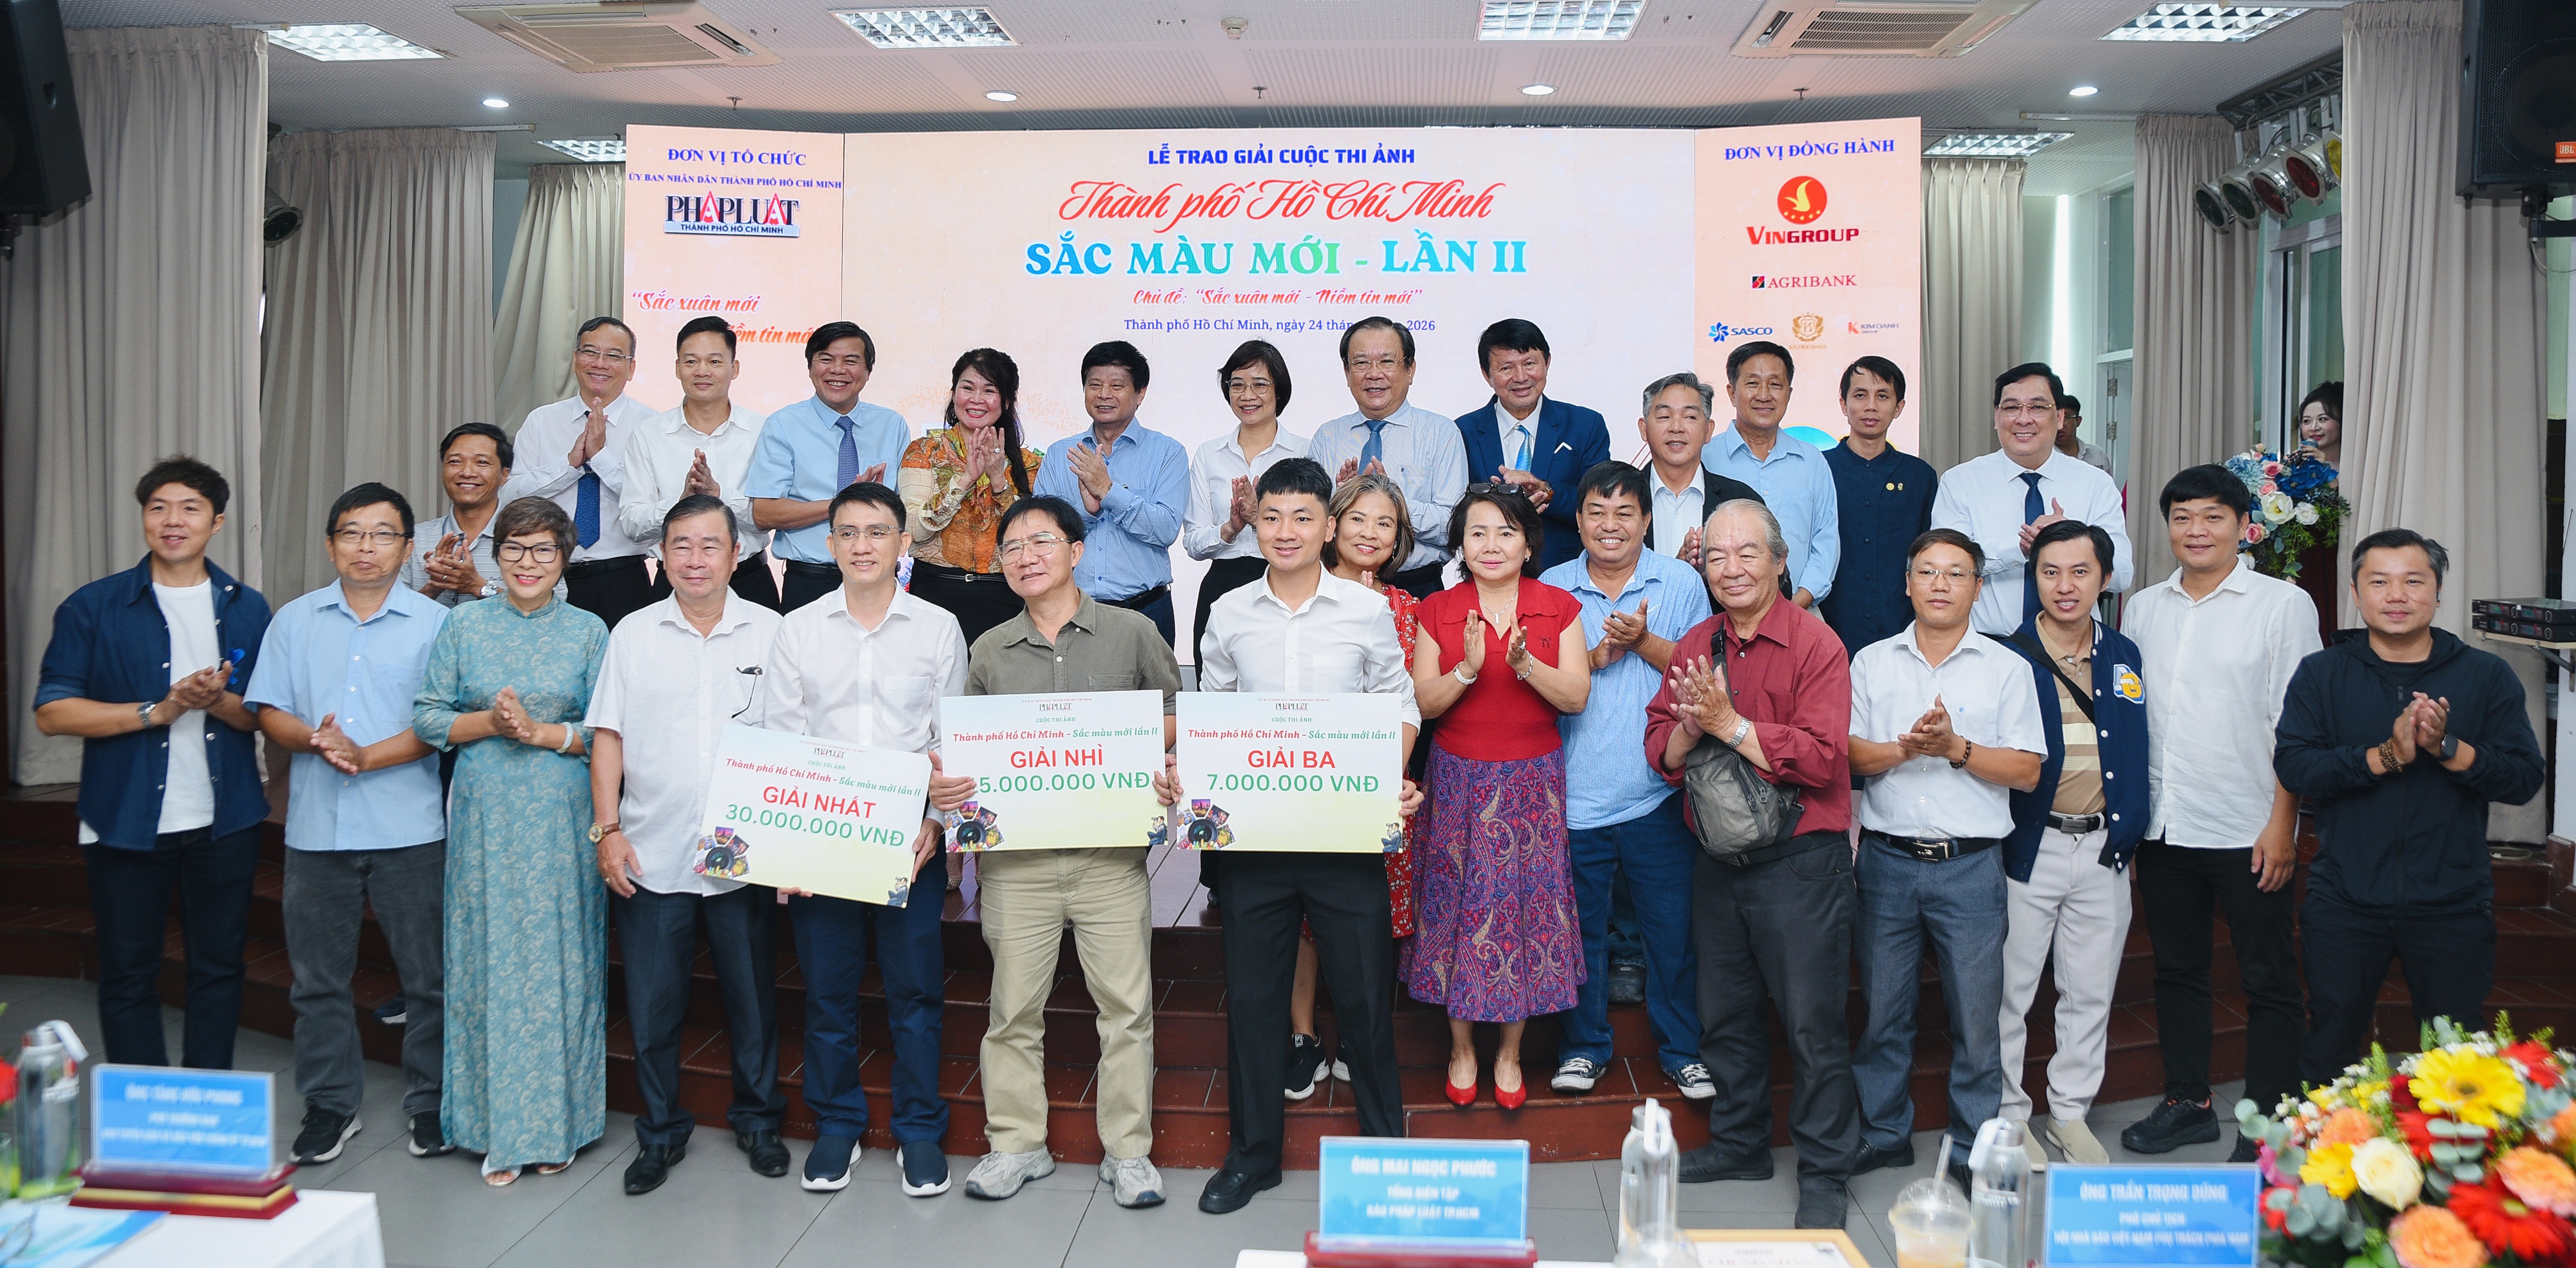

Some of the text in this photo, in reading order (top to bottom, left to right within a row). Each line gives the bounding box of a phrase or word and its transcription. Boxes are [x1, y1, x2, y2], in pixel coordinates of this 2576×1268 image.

[668, 148, 806, 166] ĐƠN VỊ TỔ CHỨC
[1149, 143, 1414, 167] LỄ TRAO GIẢI CUỘC THI ẢNH
[1725, 146, 1761, 160] ĐƠN
[1766, 146, 1784, 160] VỊ
[1844, 138, 1895, 154] HÀNH
[2560, 145, 2574, 154] JBL
[667, 174, 694, 183] NHÂN
[697, 175, 718, 184] DÂN
[720, 176, 754, 185] THÀNH
[796, 178, 813, 187] CHÍ
[816, 180, 842, 188] MINH
[1059, 179, 1506, 233] Thành phố Hồ Chí Minh
[1747, 226, 1859, 245] VINGROUP
[1026, 231, 1111, 274] SẮC
[1126, 236, 1233, 274] MÀU
[1249, 235, 1340, 274] MỚI
[1382, 229, 1477, 273] LẦN
[1492, 241, 1526, 272] II
[1768, 275, 1857, 288] AGRIBANK
[678, 295, 721, 311] xuân
[725, 295, 760, 312] mới
[1133, 289, 1160, 304] Chủ
[1163, 288, 1187, 304] đề:
[1233, 290, 1268, 304] xuân
[1270, 289, 1301, 304] mới
[1315, 288, 1357, 304] Niềm
[1360, 289, 1381, 304] tin
[727, 323, 818, 344] ềm tin mớ
[1125, 319, 1435, 332] Thành phố Hồ Chí Minh, ngày 24 thán 2026
[1731, 327, 1773, 335] SASCO
[954, 732, 983, 742] Thành
[986, 731, 1004, 743] phố
[1006, 730, 1018, 740] Hồ
[1021, 730, 1036, 739] Chí
[1039, 730, 1064, 739] Minh
[1073, 727, 1089, 738] Sắc
[1092, 728, 1112, 737] màu
[1114, 727, 1132, 736] mới
[1134, 726, 1149, 735] lần
[1188, 729, 1218, 739] Thành
[1221, 728, 1239, 740] phố
[1241, 728, 1253, 738] Hồ
[1255, 730, 1271, 738] Chí
[1309, 730, 1325, 739] Sắc
[1327, 731, 1348, 739] màu
[1351, 731, 1369, 739] mới
[1371, 729, 1387, 739] lần
[1010, 744, 1103, 768] GIẢI NHÌ
[1248, 746, 1336, 768] GIẢI BA
[726, 758, 755, 770] Thành
[756, 764, 776, 774] phố
[776, 765, 788, 775] Hồ
[790, 769, 805, 778] Chí
[807, 771, 831, 782] Minh
[839, 776, 855, 787] Sắc
[857, 780, 876, 790] màu
[878, 782, 896, 793] mới
[898, 784, 913, 795] lần
[972, 772, 1150, 793] 5.000.000 VNĐ
[1207, 773, 1378, 792] 7.000.000 VNĐ
[763, 785, 876, 819] GIẢI NHẤT
[726, 804, 904, 846] 30.000.000 VNĐ
[1351, 1155, 1379, 1174] ÔNG
[1383, 1158, 1409, 1175] MAI
[2080, 1181, 2106, 1202] ÔNG
